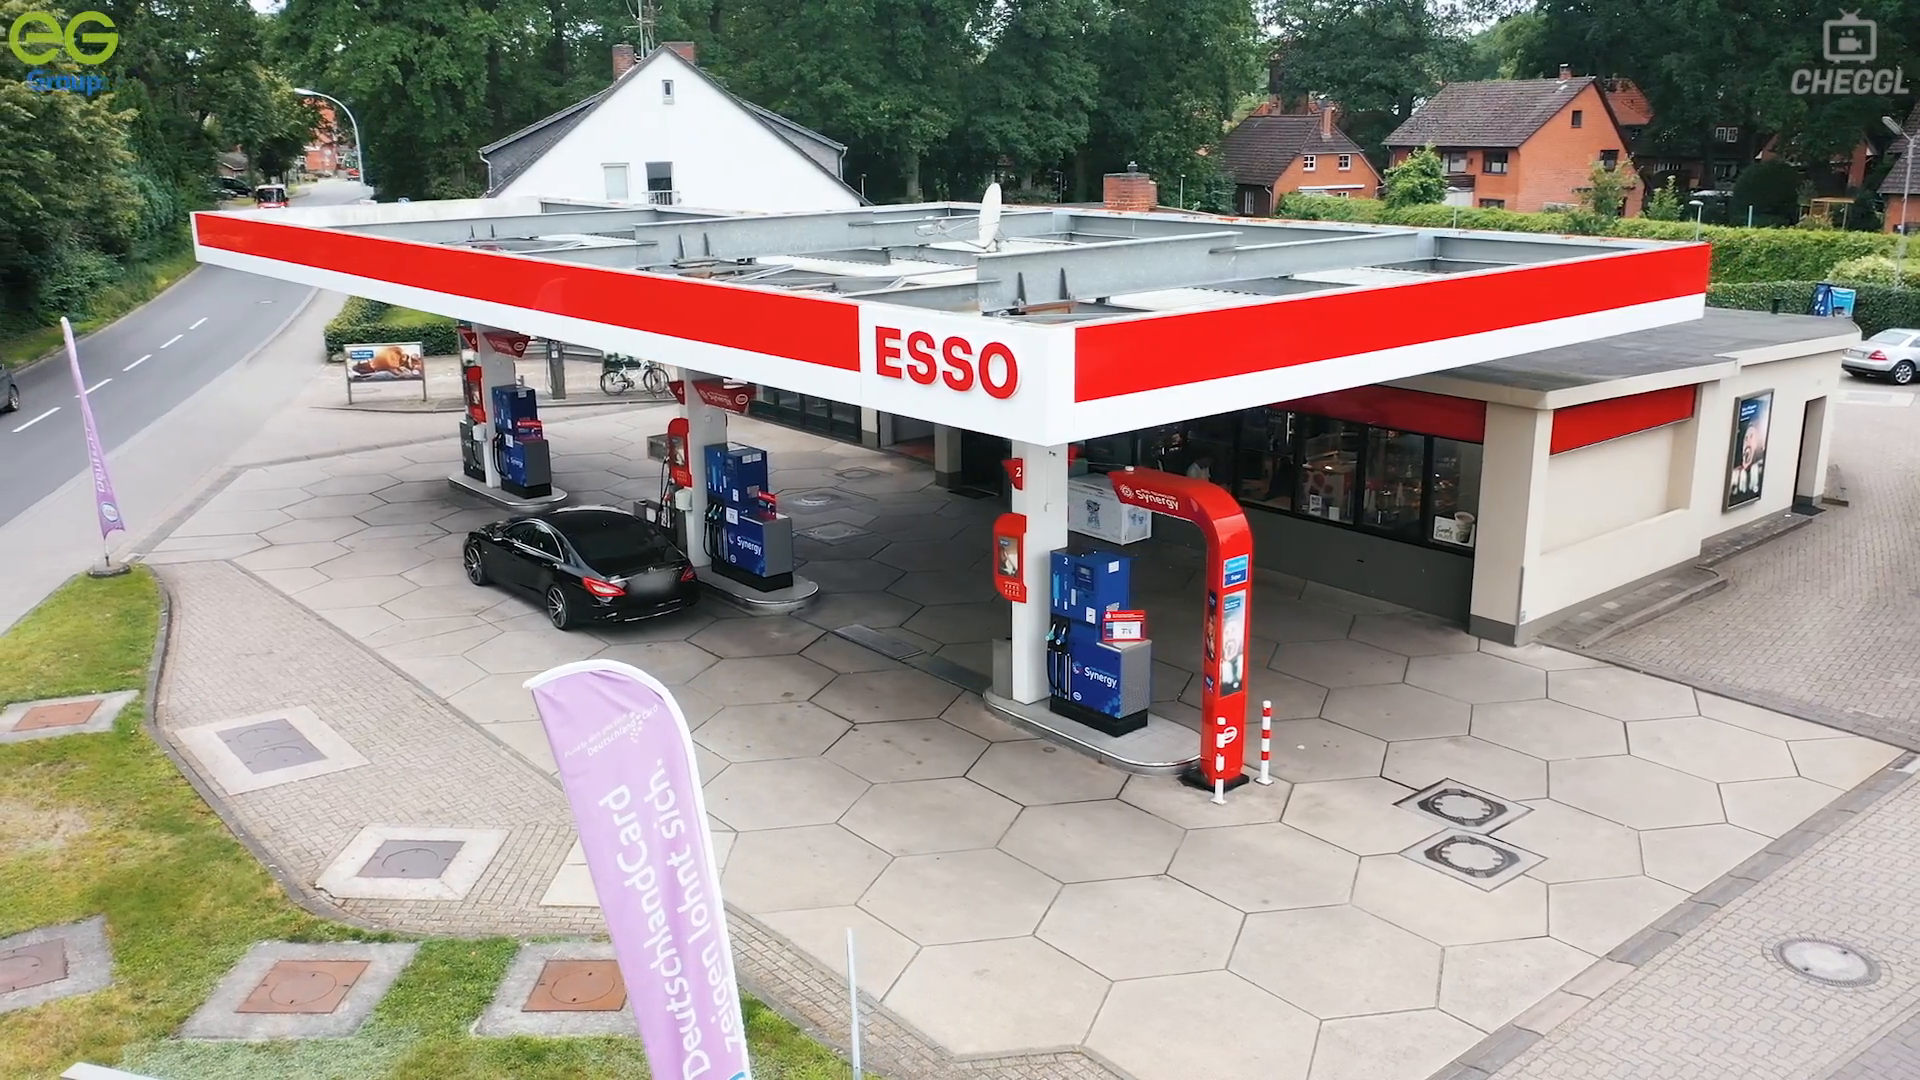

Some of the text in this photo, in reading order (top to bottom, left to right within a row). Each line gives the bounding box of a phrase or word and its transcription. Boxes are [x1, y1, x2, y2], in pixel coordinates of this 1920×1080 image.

[875, 326, 1019, 400] ESSO
[677, 387, 683, 395] 4
[1015, 467, 1022, 478] 2
[1135, 489, 1179, 511] Synergy
[737, 535, 762, 556] Synergy
[1063, 557, 1069, 565] 2
[1084, 666, 1118, 689] Synergy
[643, 758, 740, 1053] zeigen lohnt sich.
[599, 784, 711, 1080] DeutschlandCard
